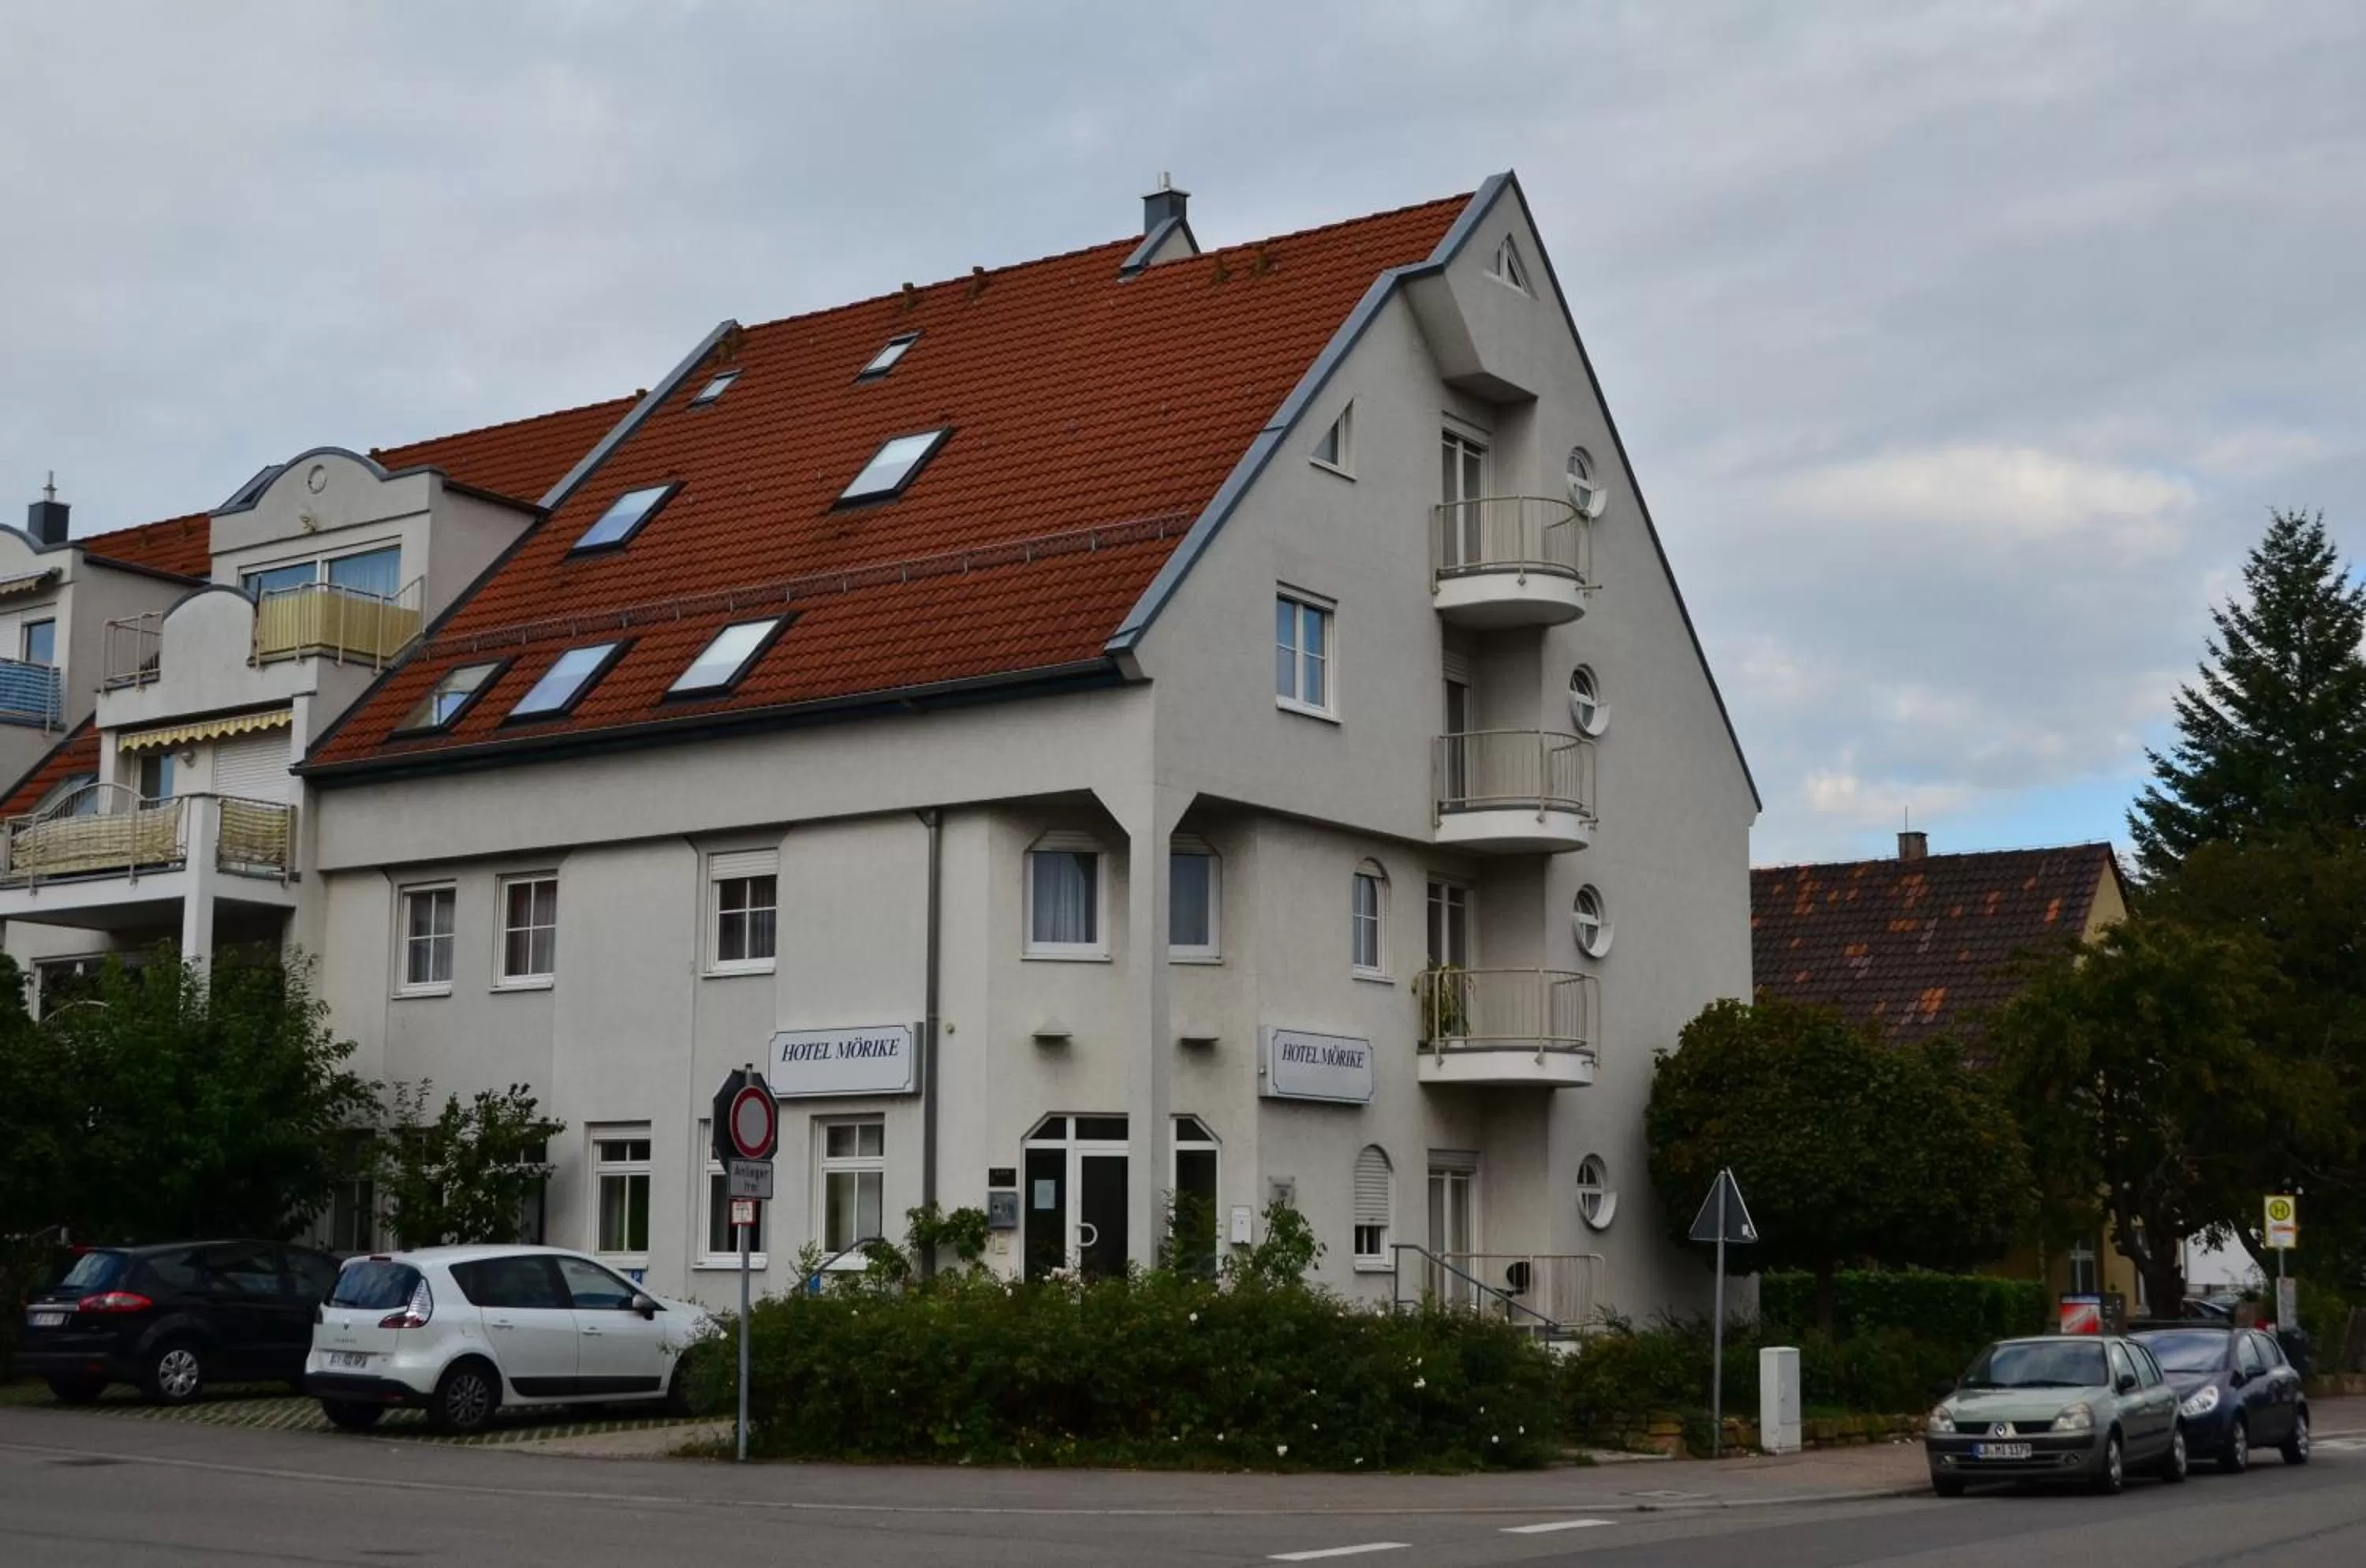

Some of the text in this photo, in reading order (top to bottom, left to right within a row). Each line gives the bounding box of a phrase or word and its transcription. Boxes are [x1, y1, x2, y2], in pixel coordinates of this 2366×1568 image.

[782, 1036, 900, 1062] HOTEL MÖRIKE
[1282, 1043, 1365, 1068] HOTEL MÖRIKE
[2274, 1205, 2286, 1217] H
